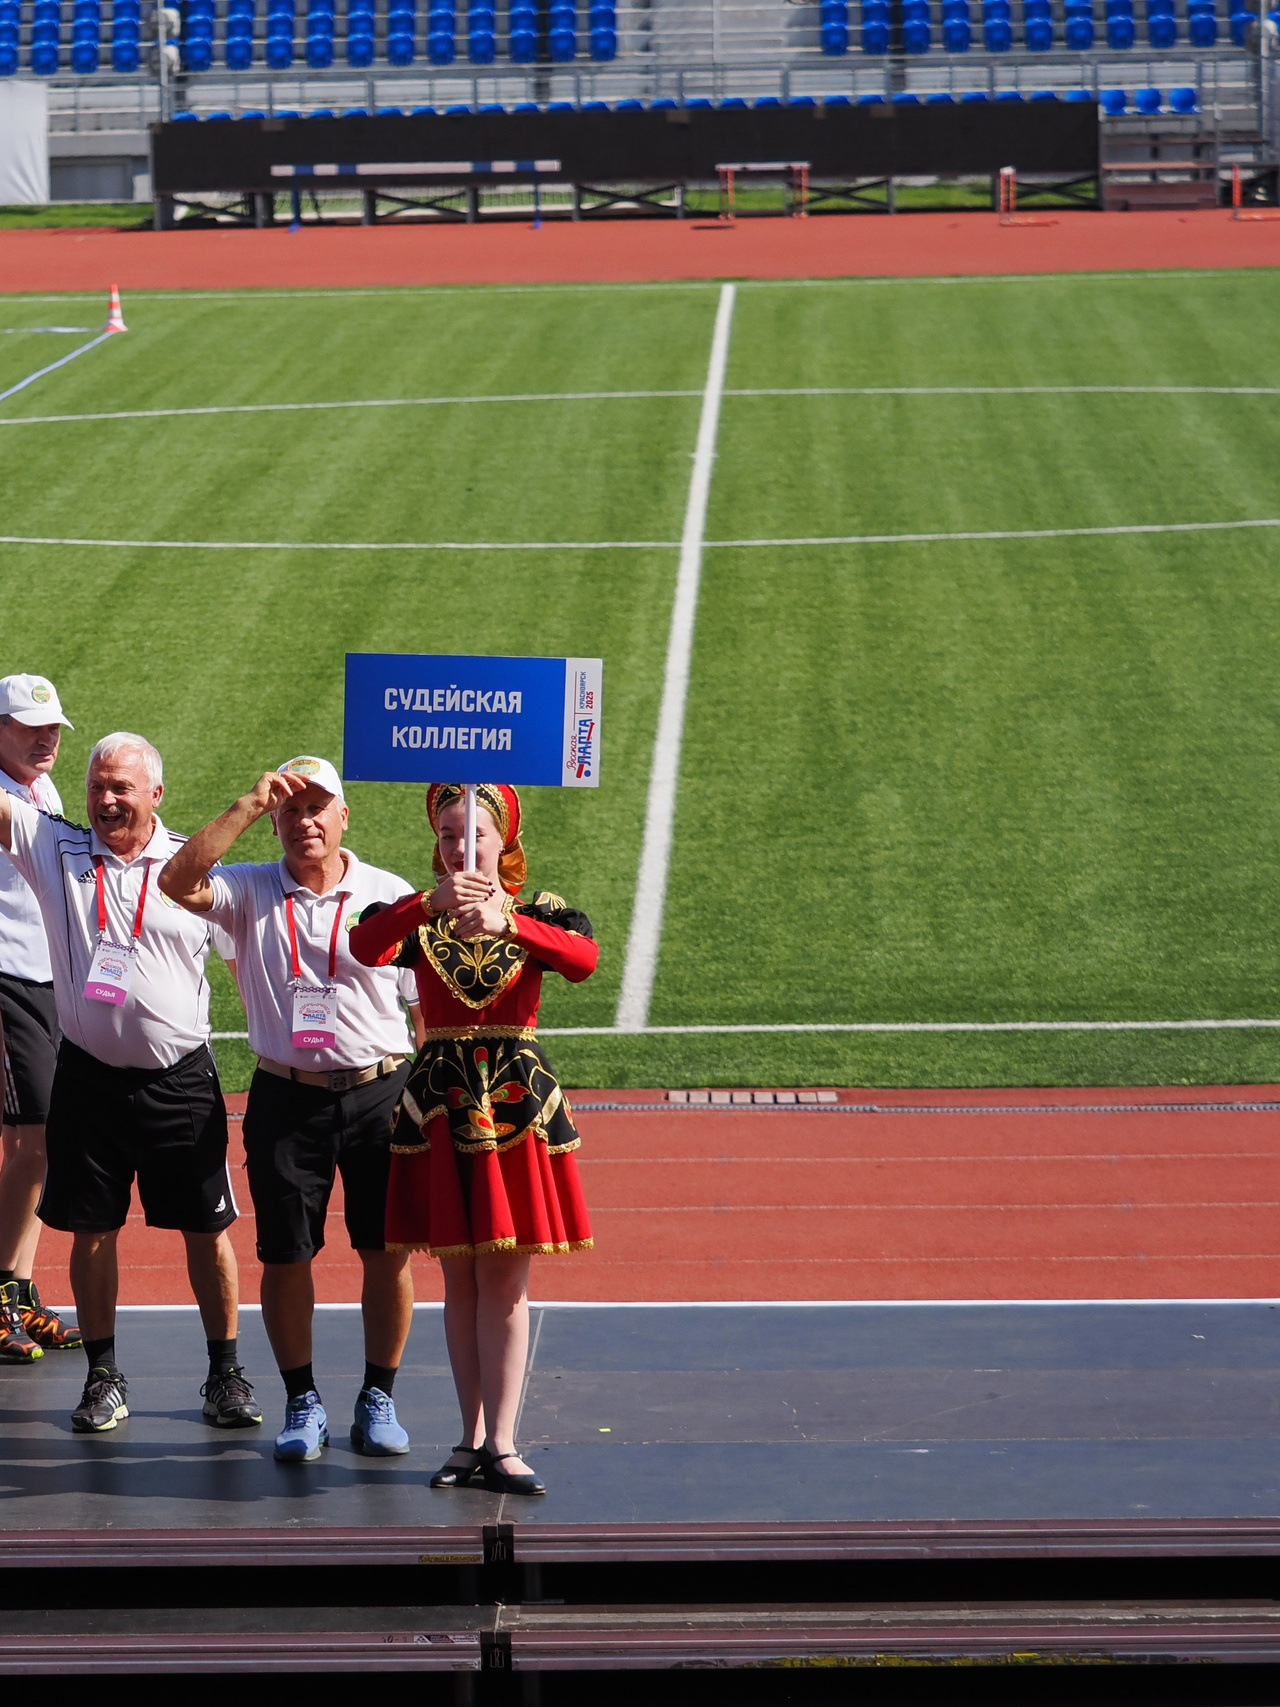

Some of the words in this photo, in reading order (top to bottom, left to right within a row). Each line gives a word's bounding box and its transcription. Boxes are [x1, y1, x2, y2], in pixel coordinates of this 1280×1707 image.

[384, 684, 522, 714] СУДЕЙСКАЯ
[586, 691, 594, 709] 2025
[391, 725, 512, 750] КОЛЛЕГИЯ
[577, 718, 593, 766] ЛАПТА
[96, 989, 115, 998] СУДЬЯ
